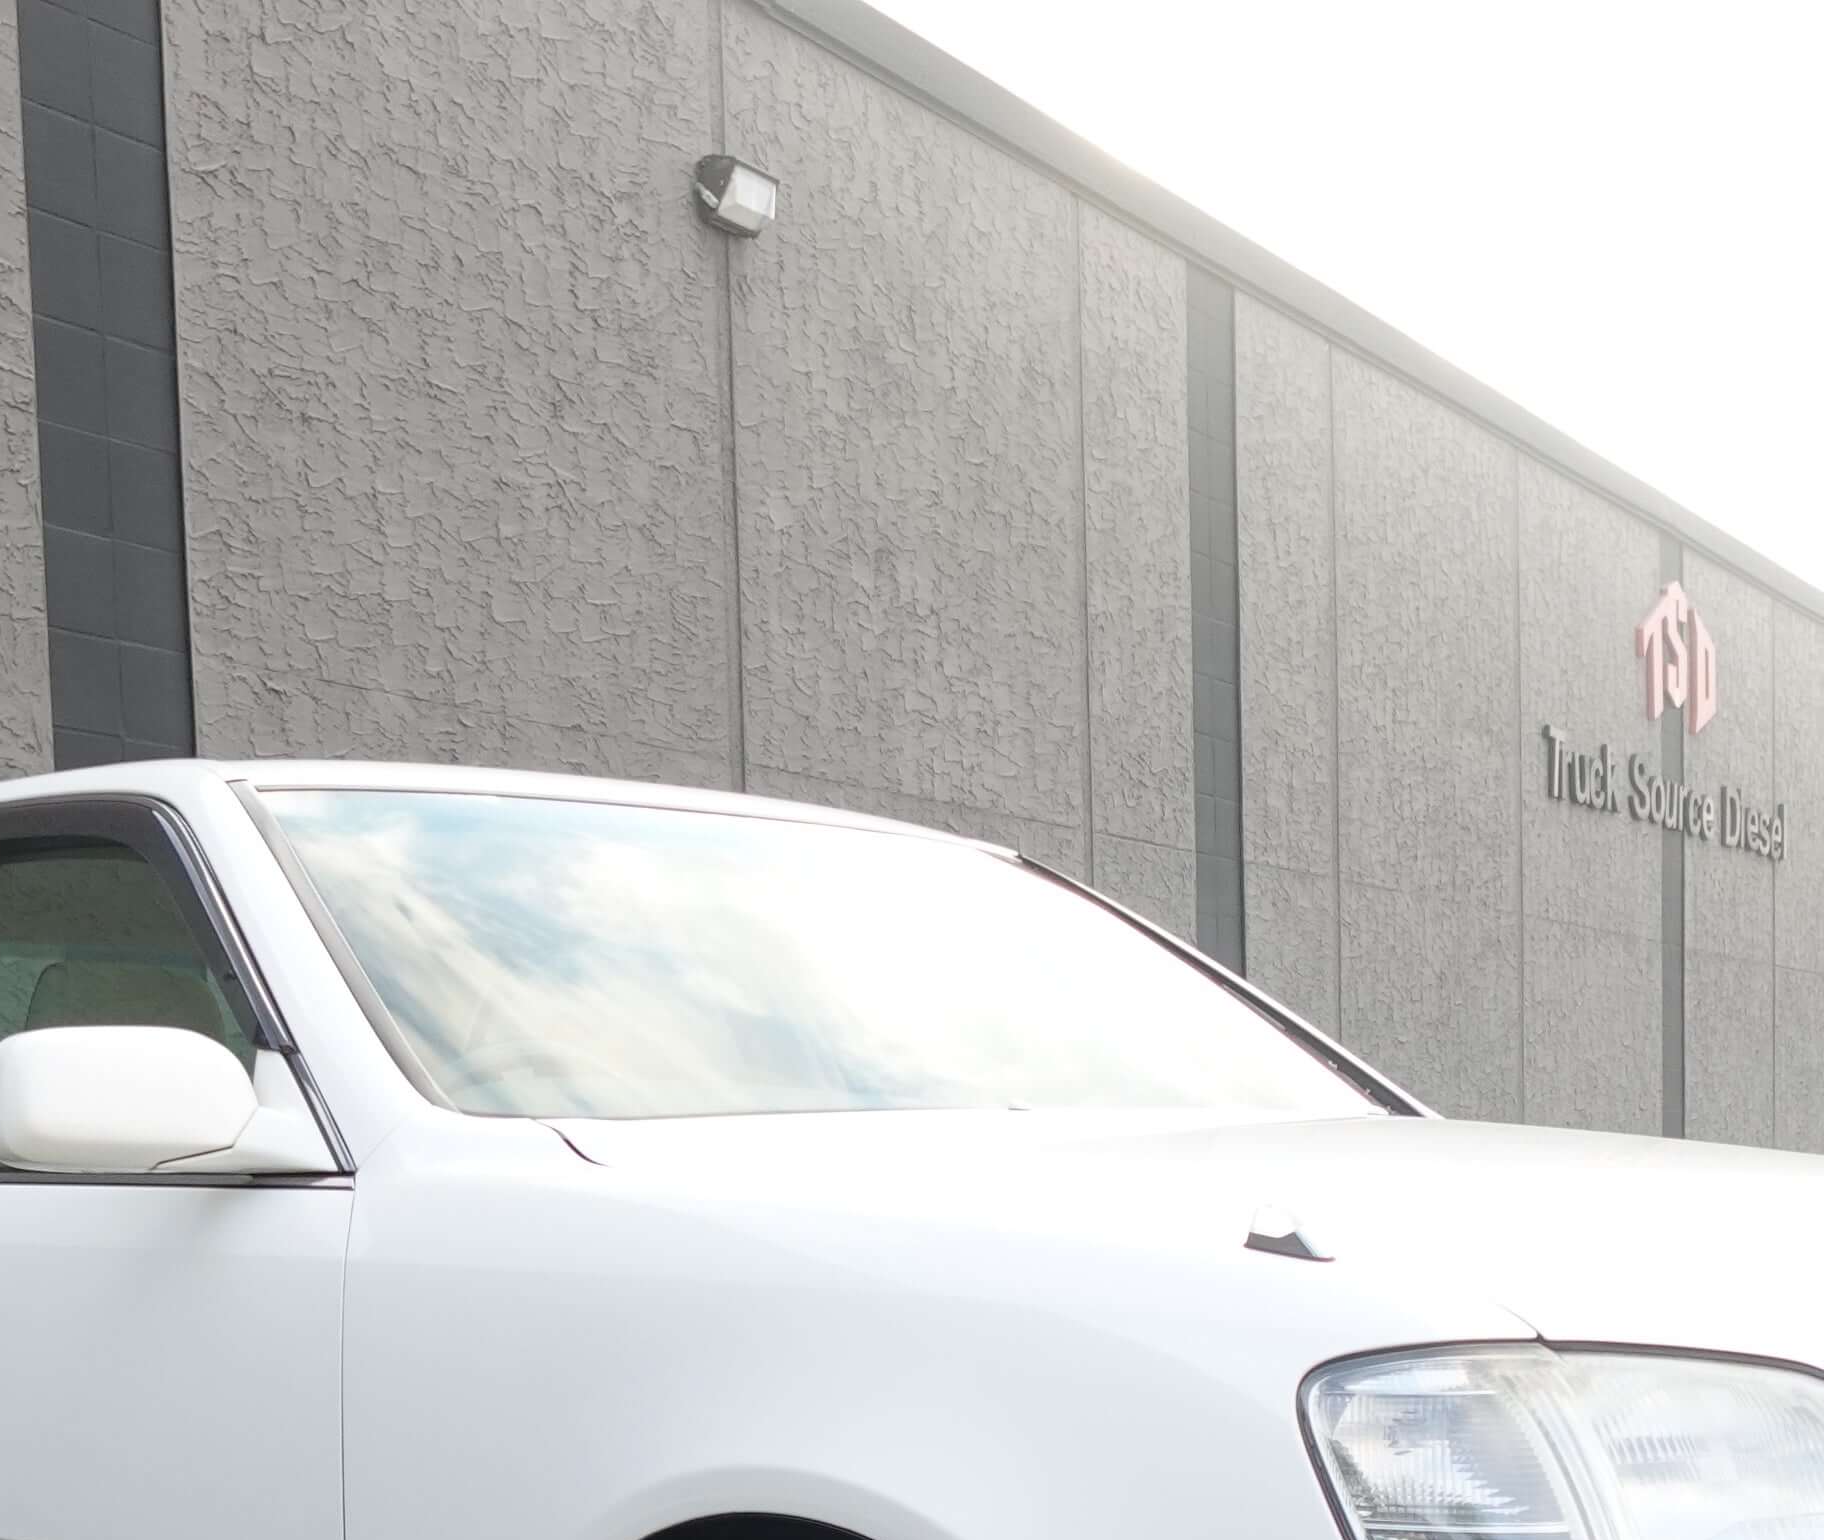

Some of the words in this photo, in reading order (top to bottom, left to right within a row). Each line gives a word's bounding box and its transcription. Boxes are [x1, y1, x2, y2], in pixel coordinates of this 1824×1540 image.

[1635, 580, 1717, 736] TSD
[1542, 724, 1619, 812] Truck
[1628, 753, 1715, 840] Source
[1720, 784, 1787, 862] Diesel
